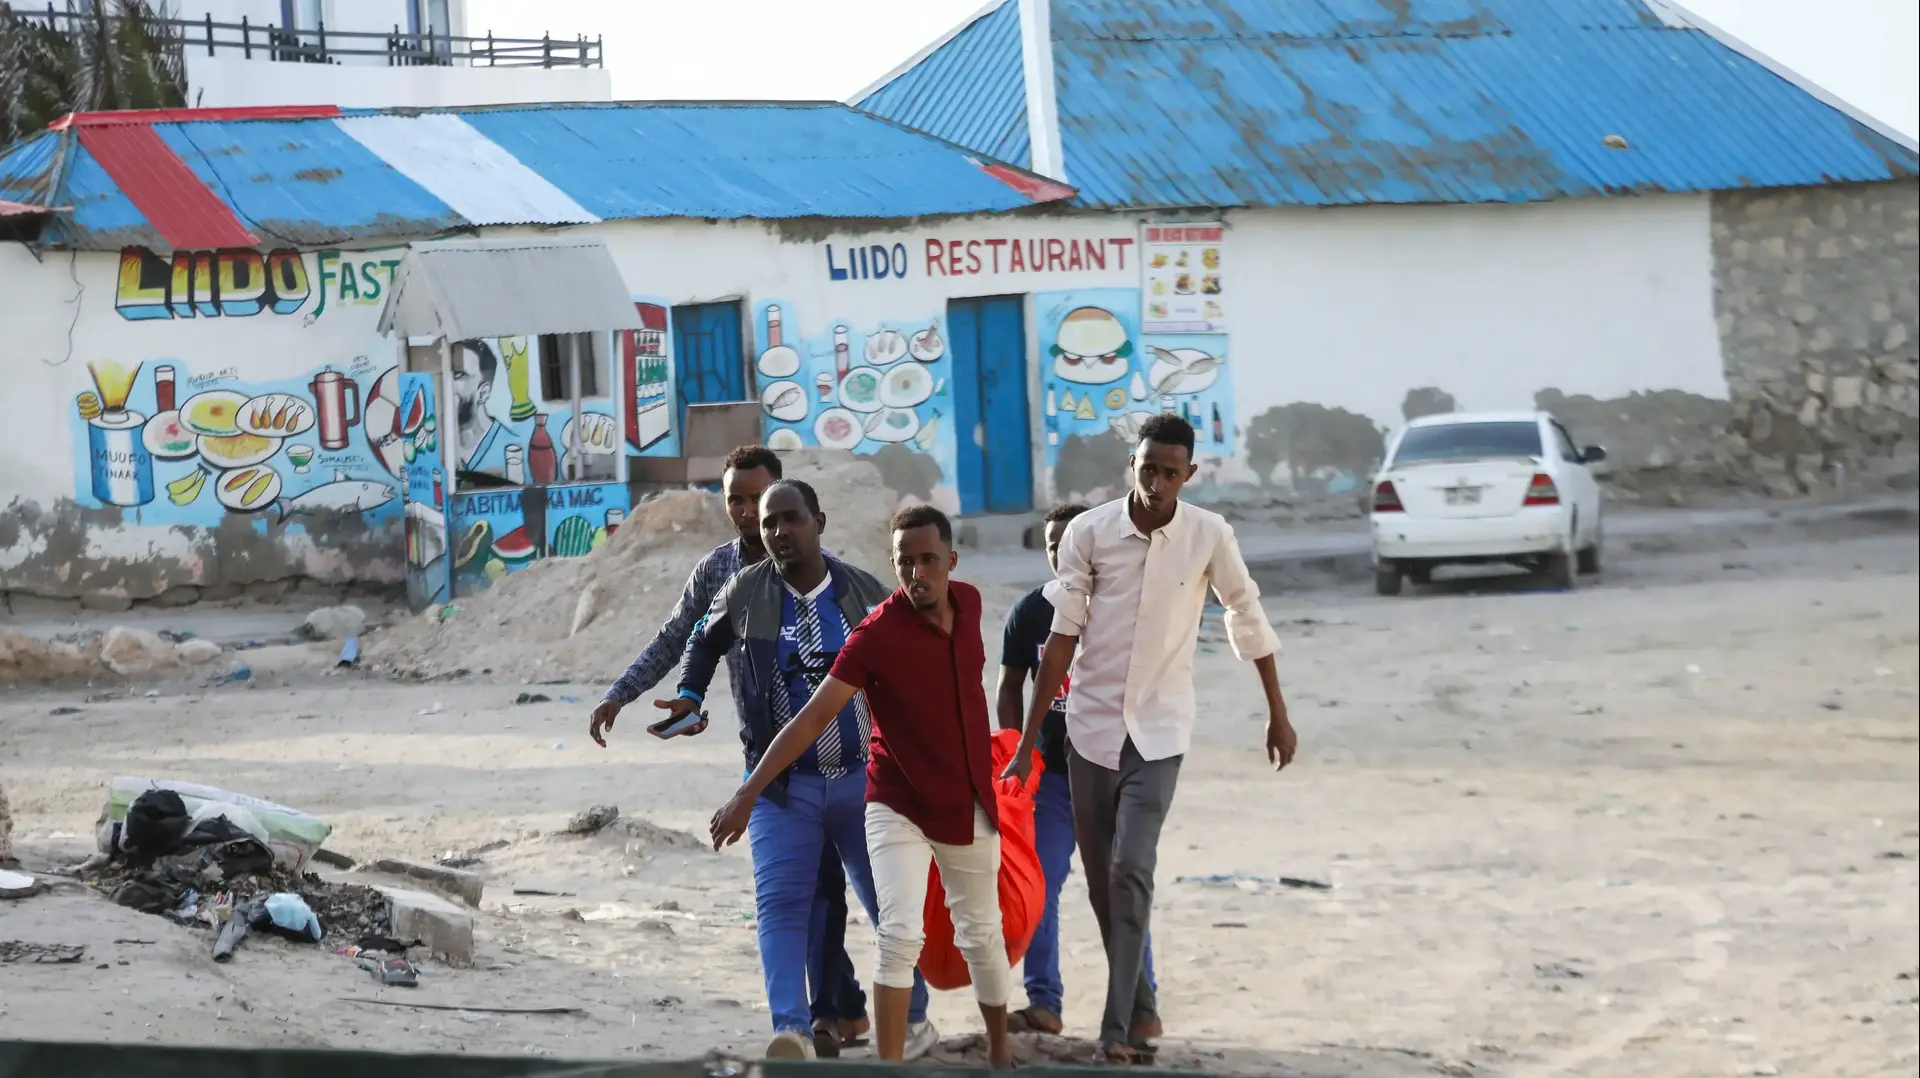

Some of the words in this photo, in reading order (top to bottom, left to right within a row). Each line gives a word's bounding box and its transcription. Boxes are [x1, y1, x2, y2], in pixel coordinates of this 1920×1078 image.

[825, 243, 907, 281] LIIDO
[925, 238, 1134, 277] RESTAURANT
[115, 245, 311, 321] LIIDO
[306, 251, 400, 322] FAST
[568, 487, 603, 507] MAC
